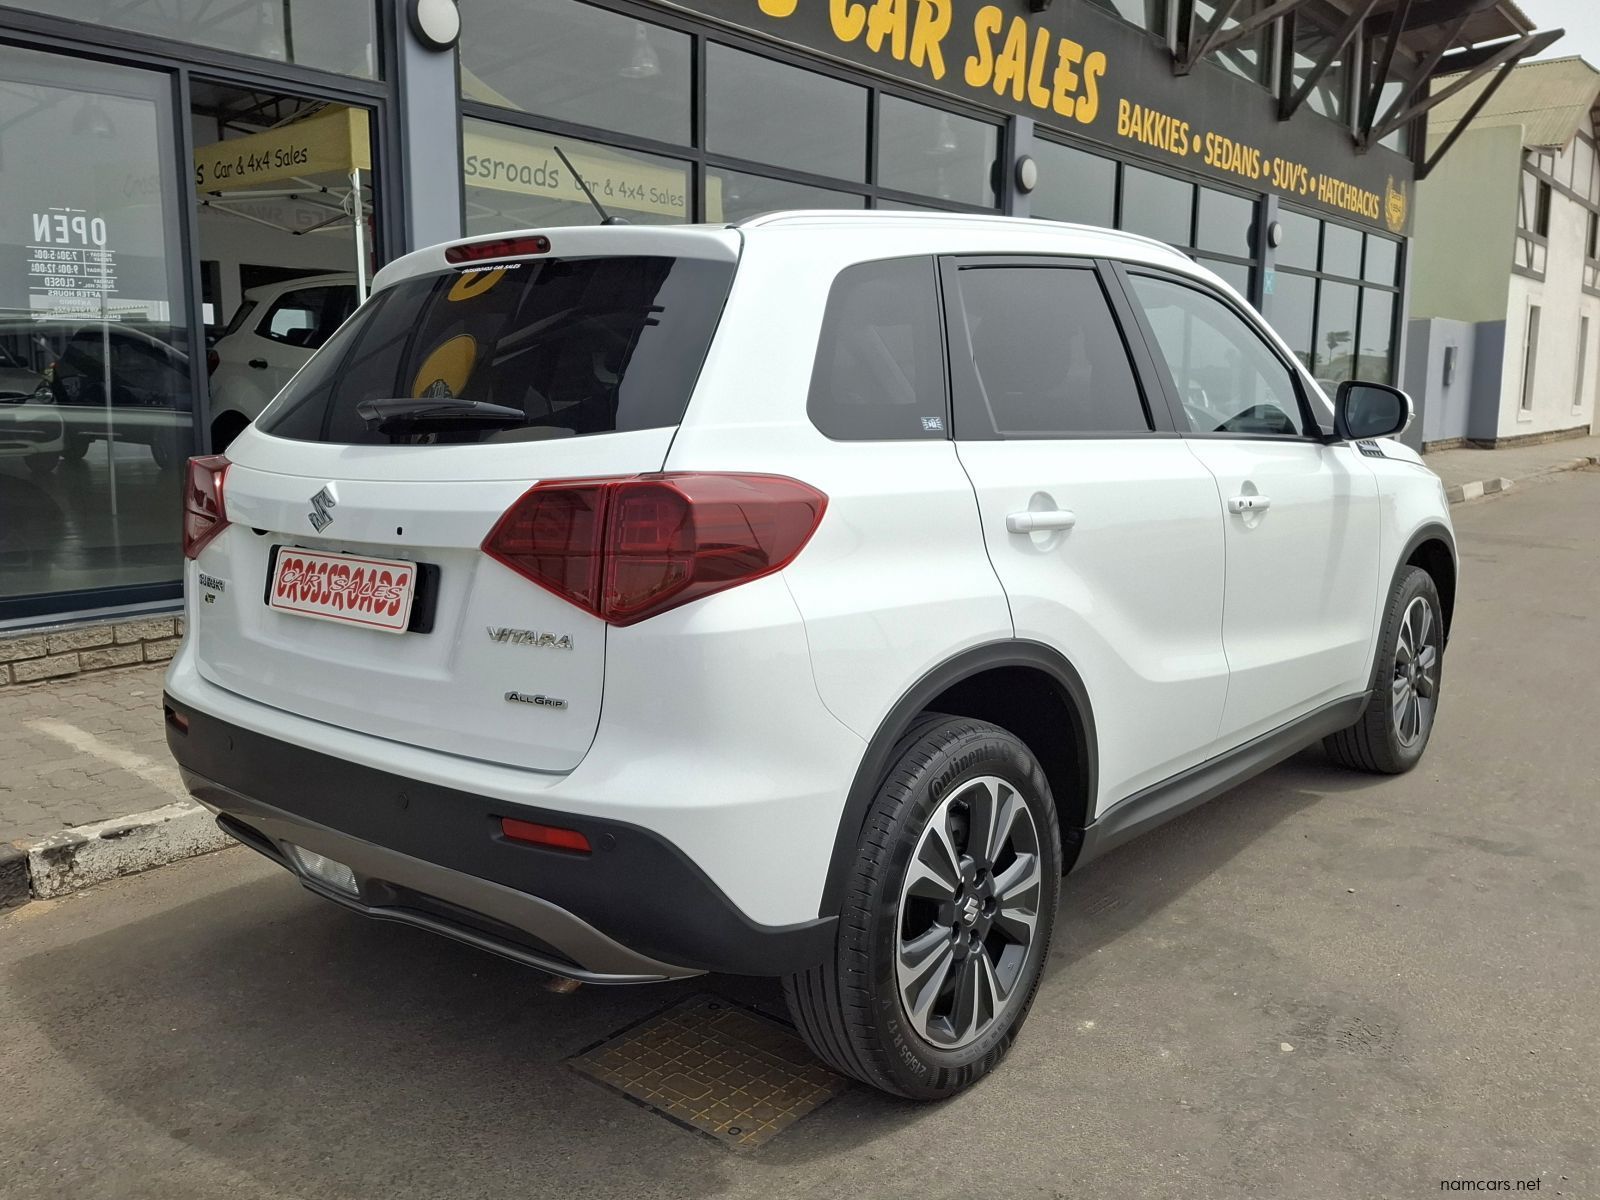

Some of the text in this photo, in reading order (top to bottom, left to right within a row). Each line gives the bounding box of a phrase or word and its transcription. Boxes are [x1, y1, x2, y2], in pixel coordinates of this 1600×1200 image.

[964, 5, 1106, 125] SALES
[213, 161, 232, 180] Car
[236, 156, 245, 176] &
[247, 151, 270, 173] 4x4
[275, 145, 308, 168] Sales
[1117, 98, 1189, 157] BAKKIES
[1204, 132, 1260, 180] SEDANS
[1272, 157, 1308, 195] SUV'S
[1318, 174, 1379, 220] HATCHBACKS
[603, 178, 613, 196] &
[618, 182, 644, 201] 4x4
[649, 187, 684, 207] Sales
[277, 557, 408, 617] CROSSROADS
[281, 571, 402, 600] CAR SALES
[486, 625, 574, 651] VITARA
[928, 741, 1002, 804] Continental
[900, 1044, 927, 1078] 215/55
